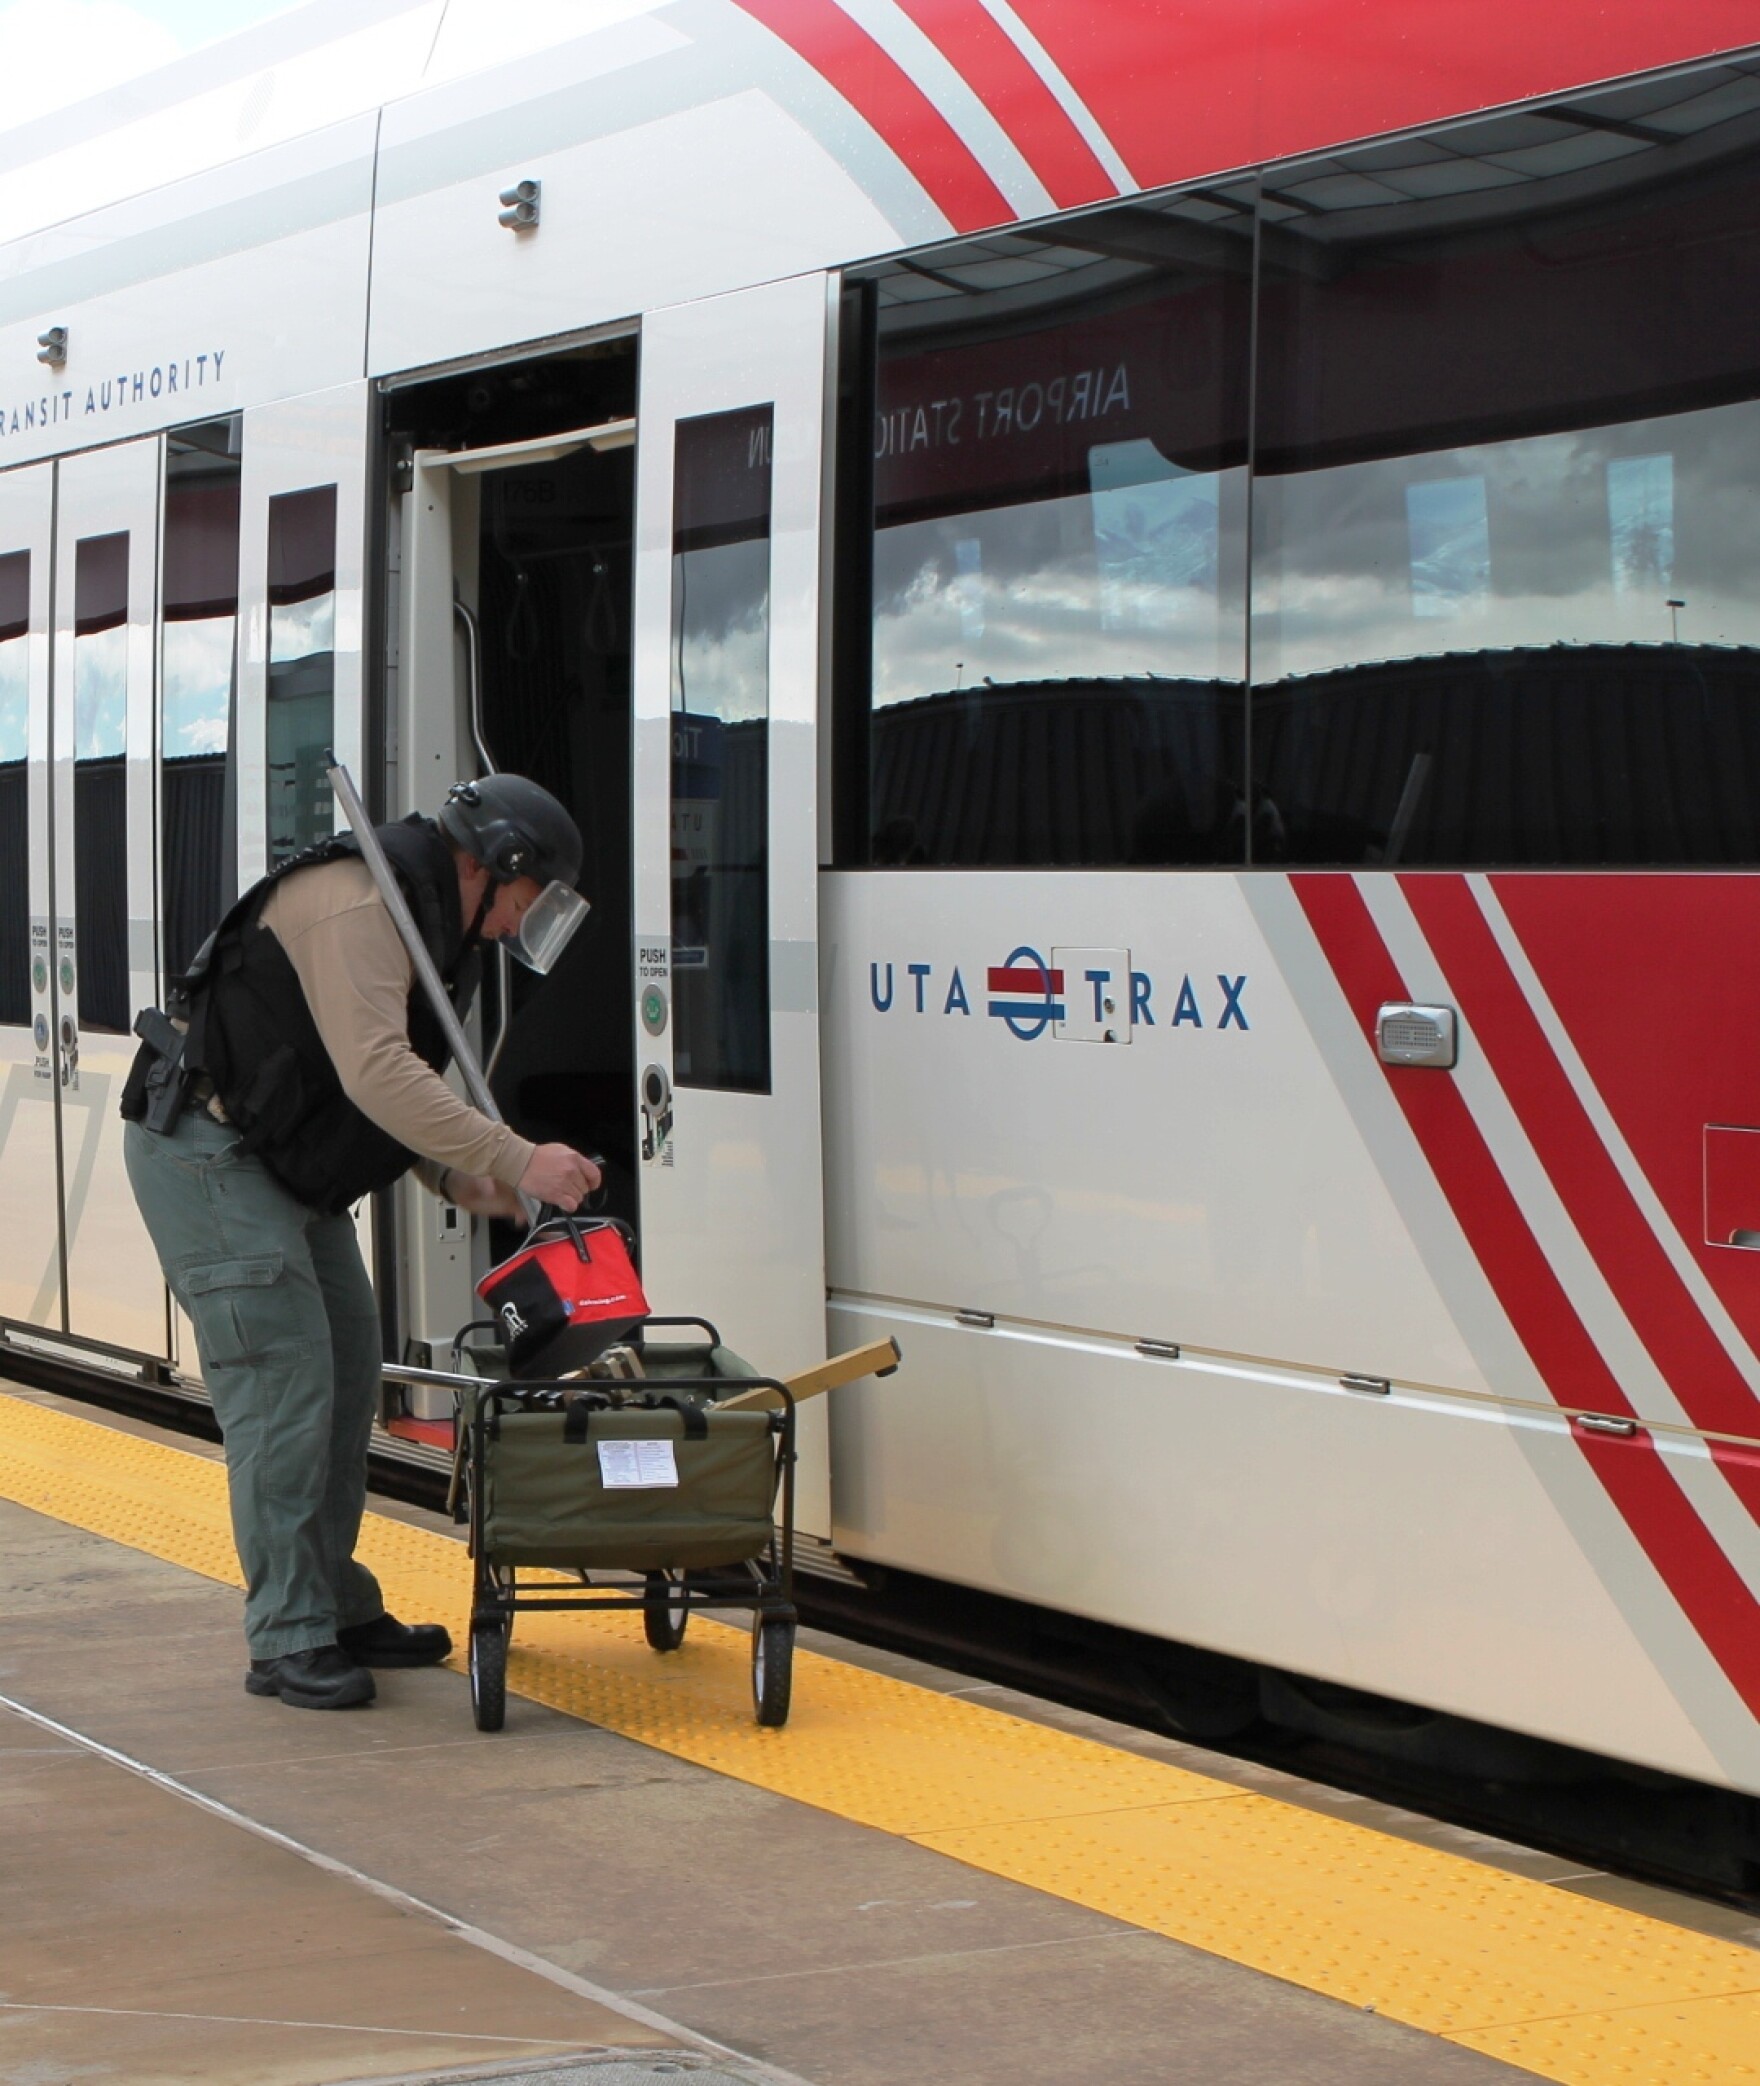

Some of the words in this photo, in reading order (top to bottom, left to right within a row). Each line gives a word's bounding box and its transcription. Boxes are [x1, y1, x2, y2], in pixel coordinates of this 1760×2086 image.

[85, 350, 225, 414] AUTHORITY
[639, 966, 648, 977] TO
[650, 967, 668, 977] OPEN
[640, 947, 666, 963] PUSH
[870, 962, 970, 1016] UTA
[1085, 970, 1250, 1031] TRAX
